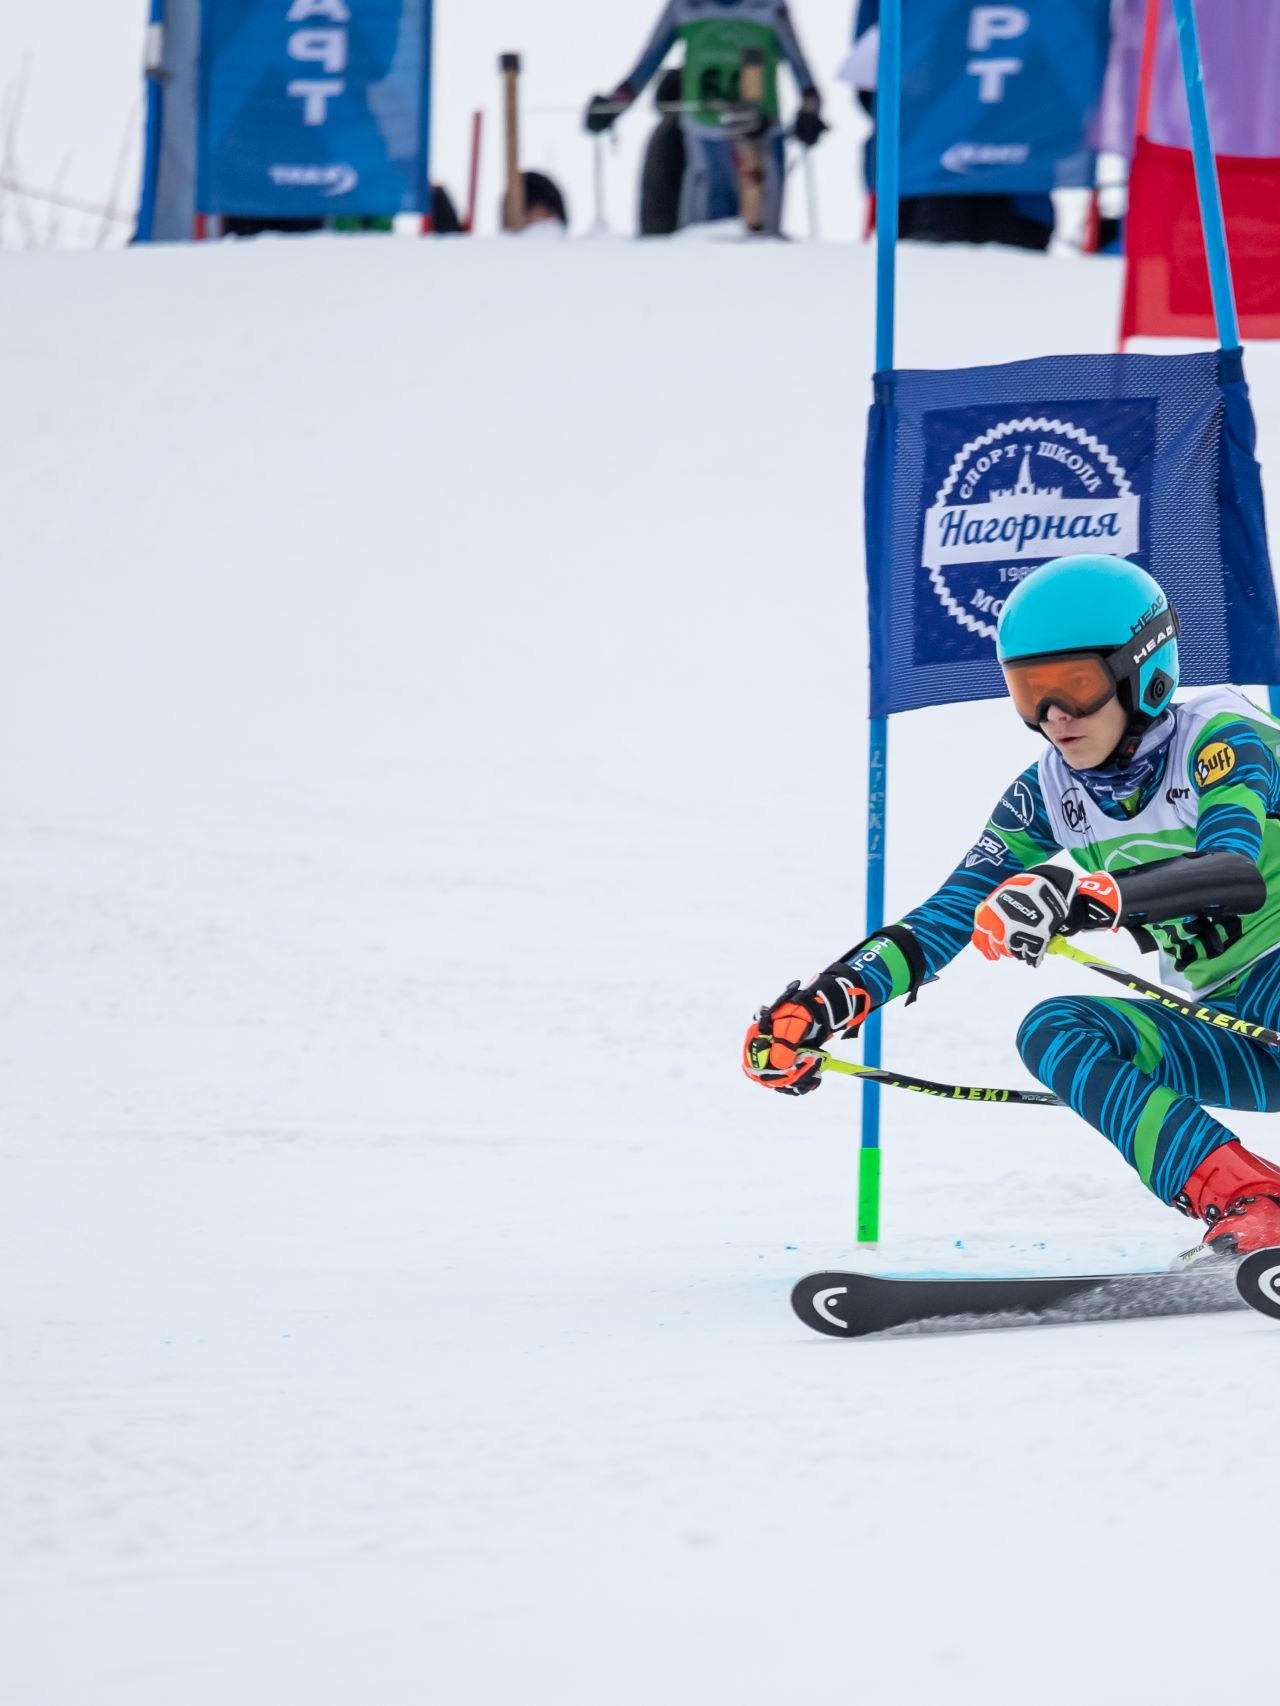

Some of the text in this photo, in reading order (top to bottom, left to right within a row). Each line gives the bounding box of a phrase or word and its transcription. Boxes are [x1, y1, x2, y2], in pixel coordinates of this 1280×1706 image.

[959, 441, 1103, 500] СПОРТ ШКОЛА
[939, 509, 1121, 553] Нагорная
[1130, 594, 1165, 636] HEAD
[1133, 625, 1173, 664] HEAD
[1000, 892, 1038, 920] reusch
[1195, 1007, 1266, 1038] LEKI
[952, 1086, 1010, 1102] LEKI
